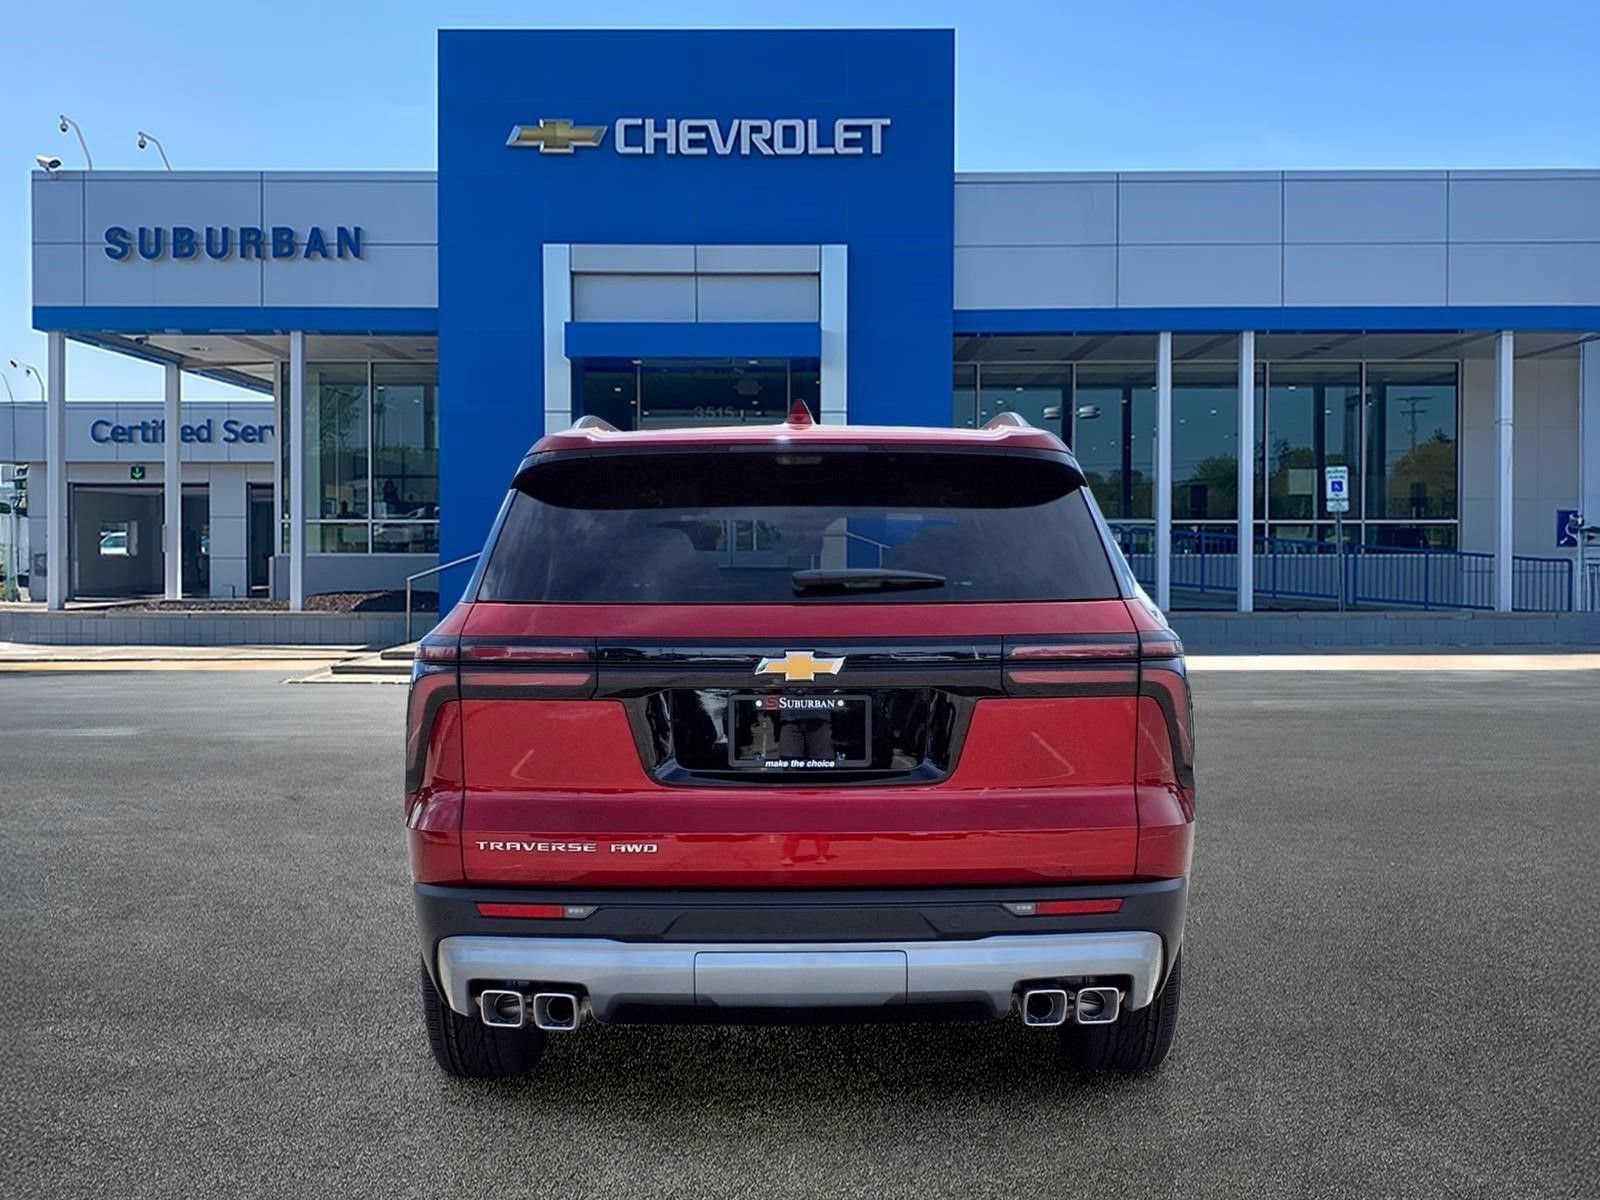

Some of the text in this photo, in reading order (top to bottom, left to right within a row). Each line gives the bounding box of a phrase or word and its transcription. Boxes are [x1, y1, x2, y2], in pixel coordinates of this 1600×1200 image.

[615, 118, 891, 155] CHEVROLET
[104, 226, 362, 260] SUBURBAN
[90, 419, 212, 443] Certifed
[791, 759, 804, 767] the
[807, 759, 835, 767] choice
[476, 841, 657, 853] TRAVERSE AWD
